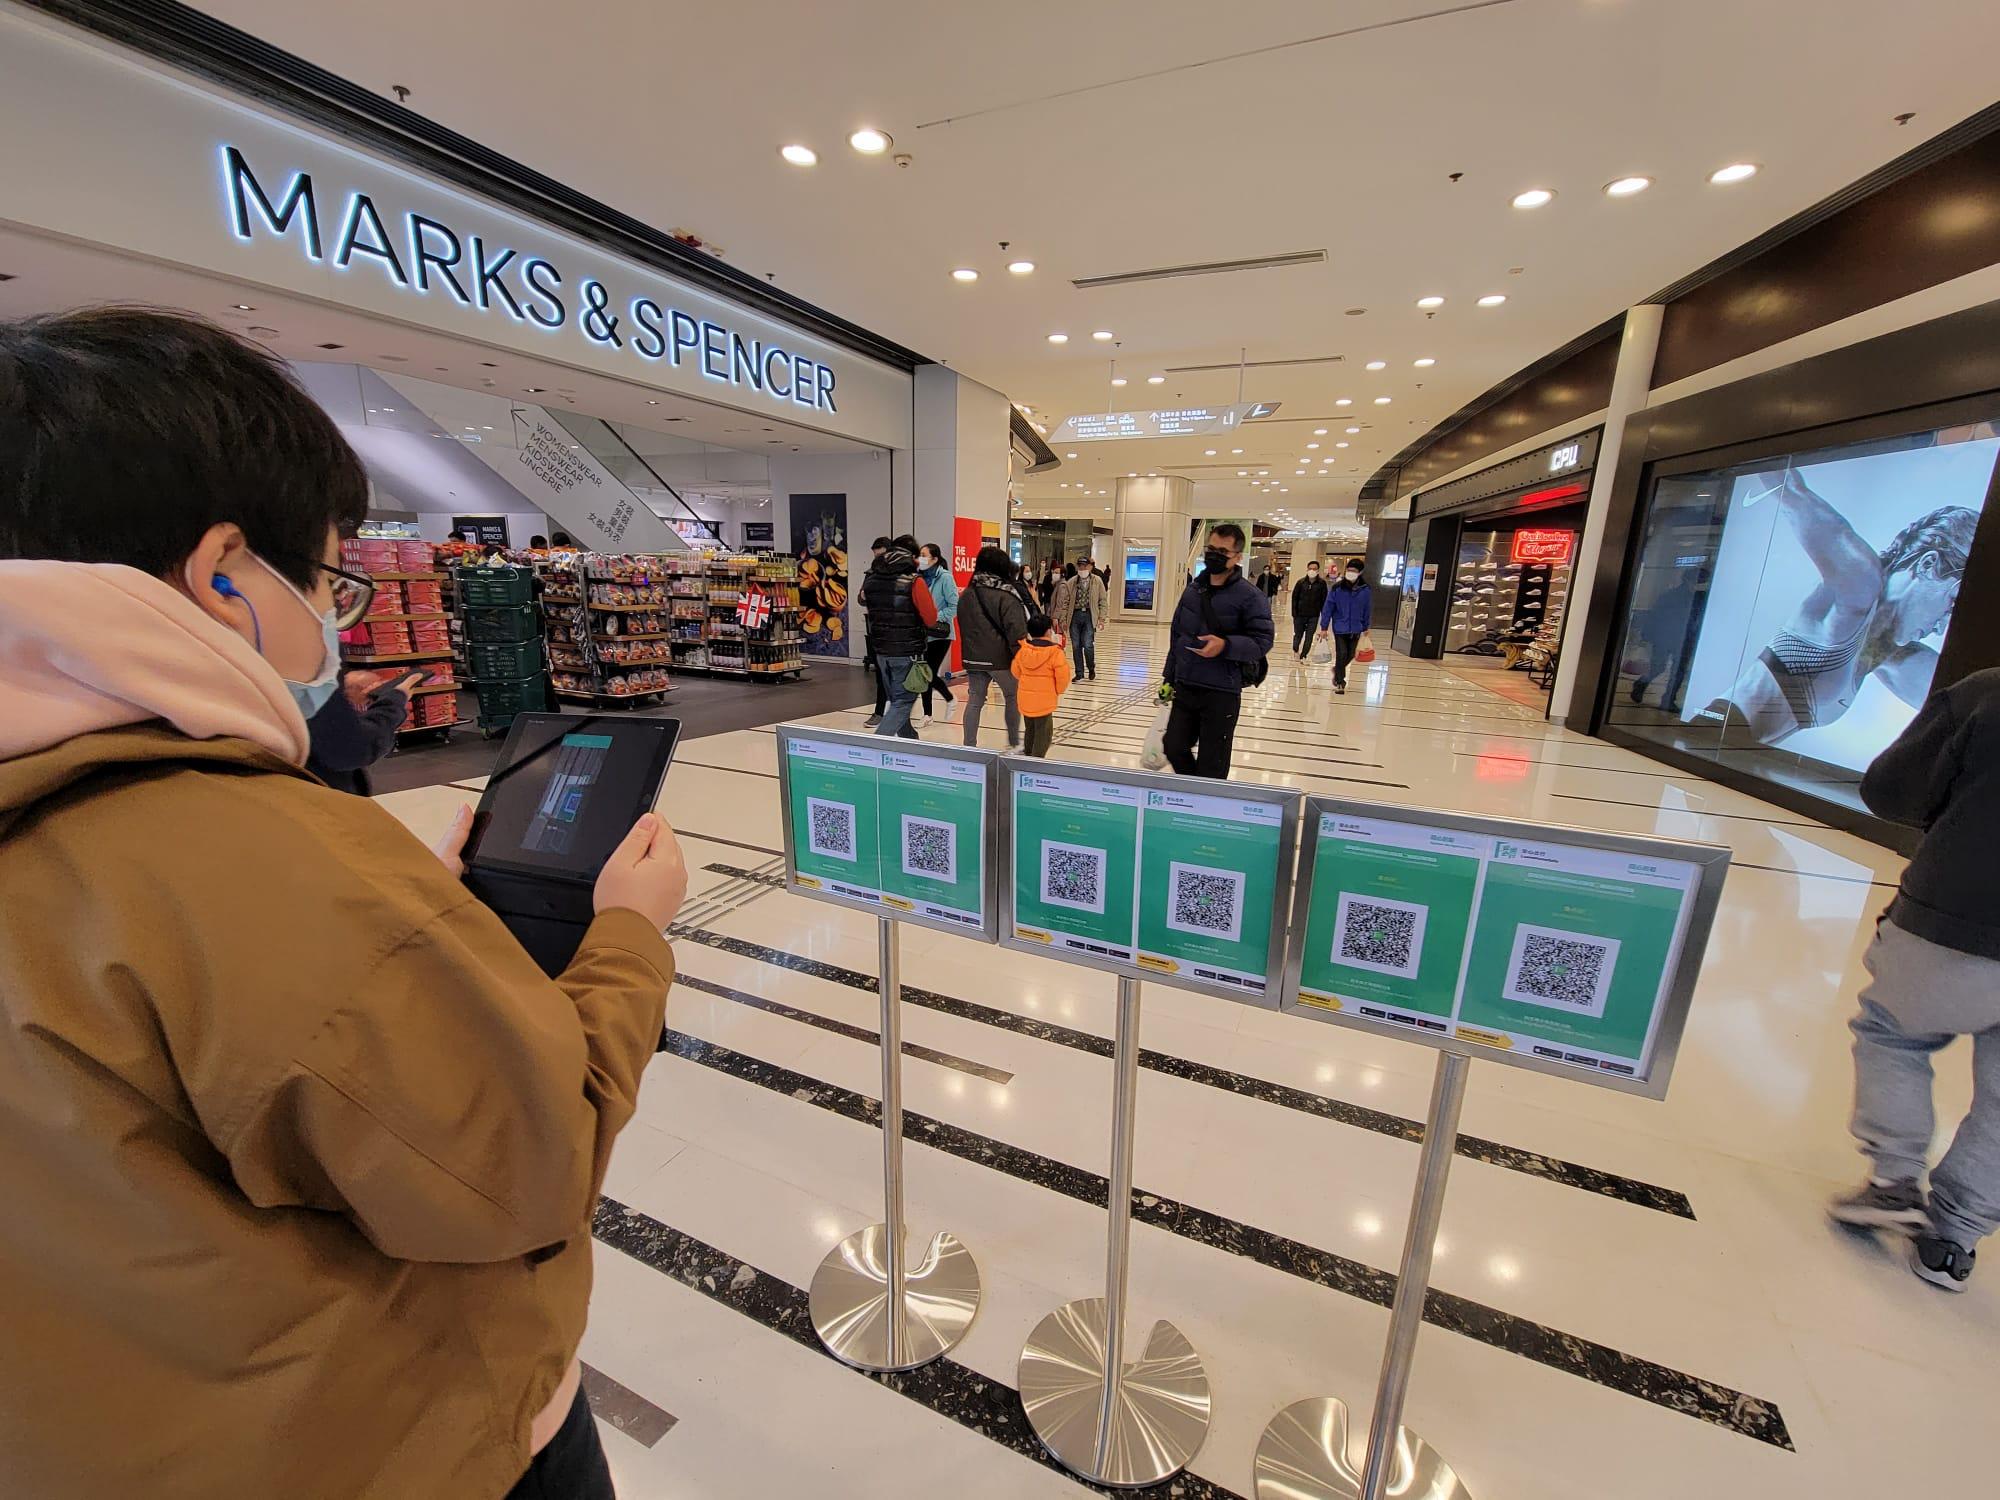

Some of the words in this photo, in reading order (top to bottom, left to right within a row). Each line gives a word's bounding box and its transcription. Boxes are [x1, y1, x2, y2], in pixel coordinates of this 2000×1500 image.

[219, 145, 564, 327] MARKS
[582, 281, 622, 348] &
[631, 297, 837, 414] SPENCER
[524, 443, 575, 491] KIDSWEAR
[530, 433, 584, 485] MENSWEAR
[536, 422, 602, 488] WOMENSWEAR
[955, 546, 966, 555] THE
[955, 557, 976, 572] SALE
